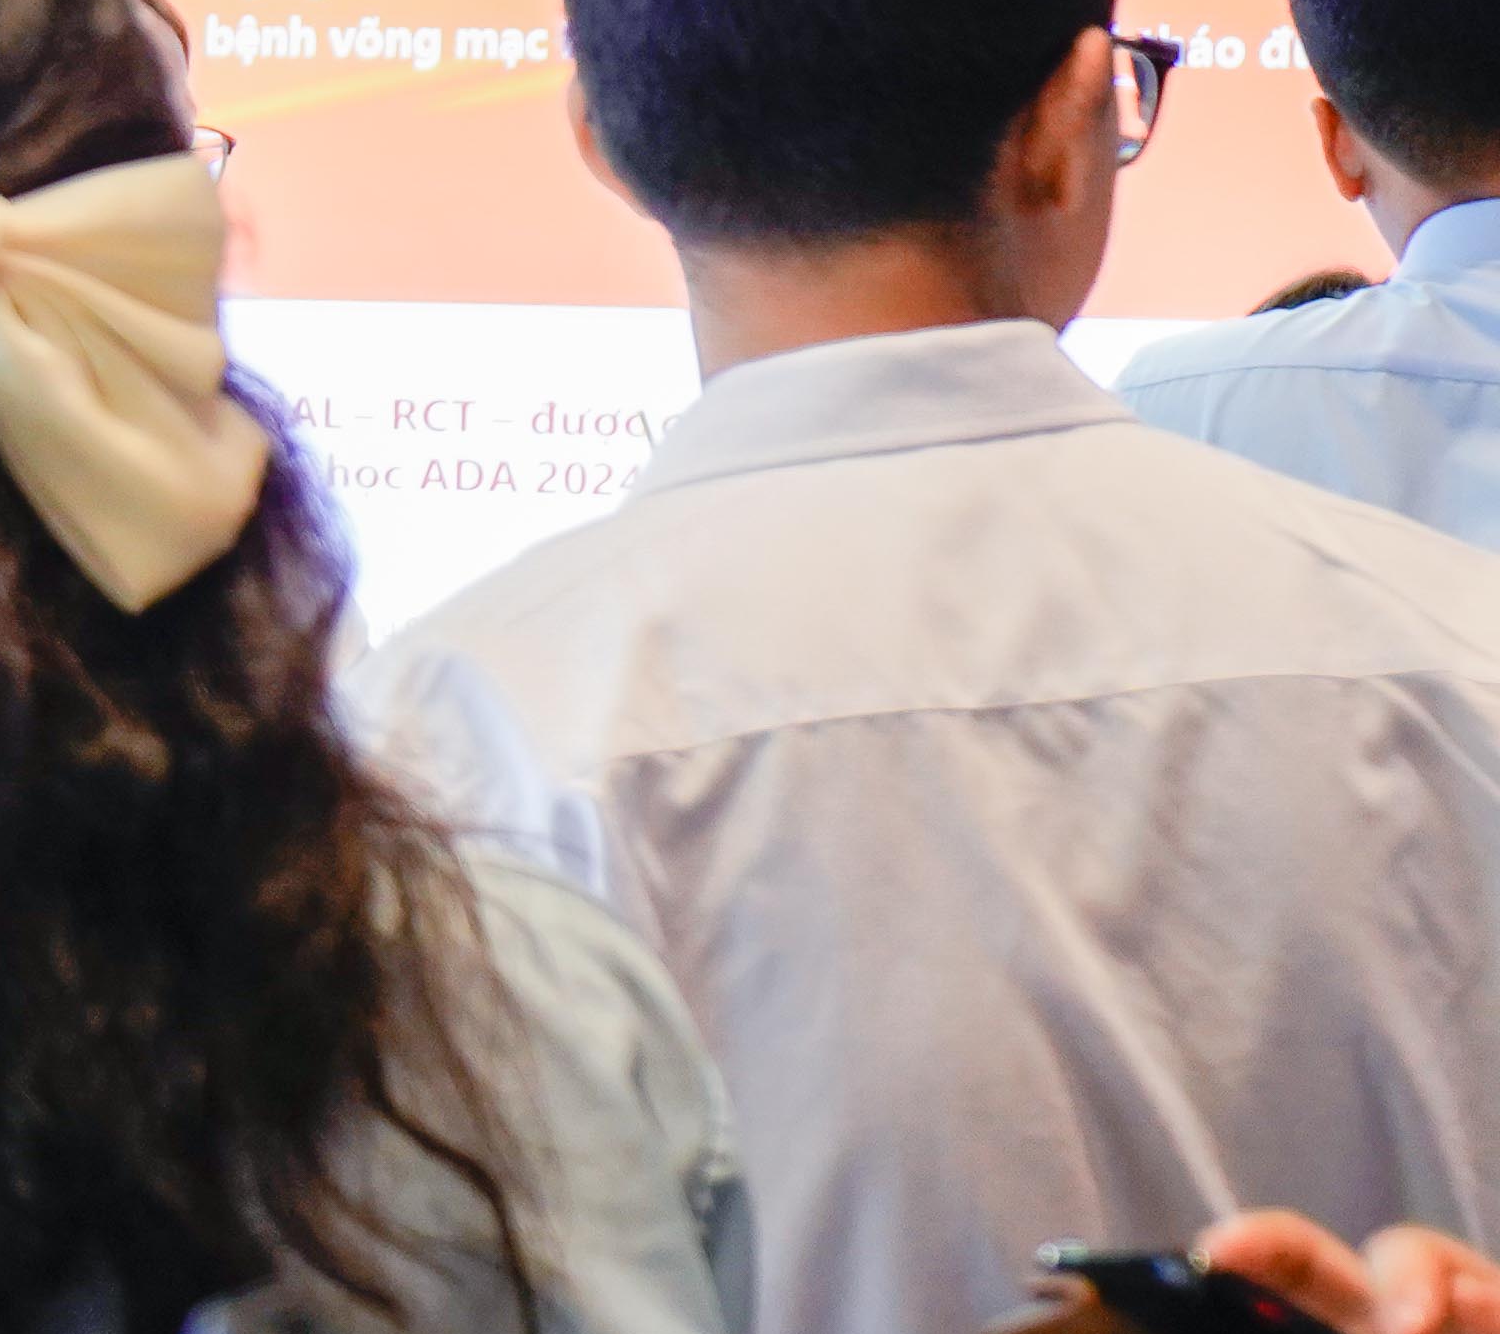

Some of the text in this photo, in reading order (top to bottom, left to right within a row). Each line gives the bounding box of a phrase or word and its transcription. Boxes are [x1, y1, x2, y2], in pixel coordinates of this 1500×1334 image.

[204, 11, 318, 67] bệnh
[328, 14, 443, 72] võng
[454, 26, 550, 71] mạc
[294, 397, 343, 431] AL
[392, 398, 477, 433] RCT
[420, 458, 518, 493] ADA
